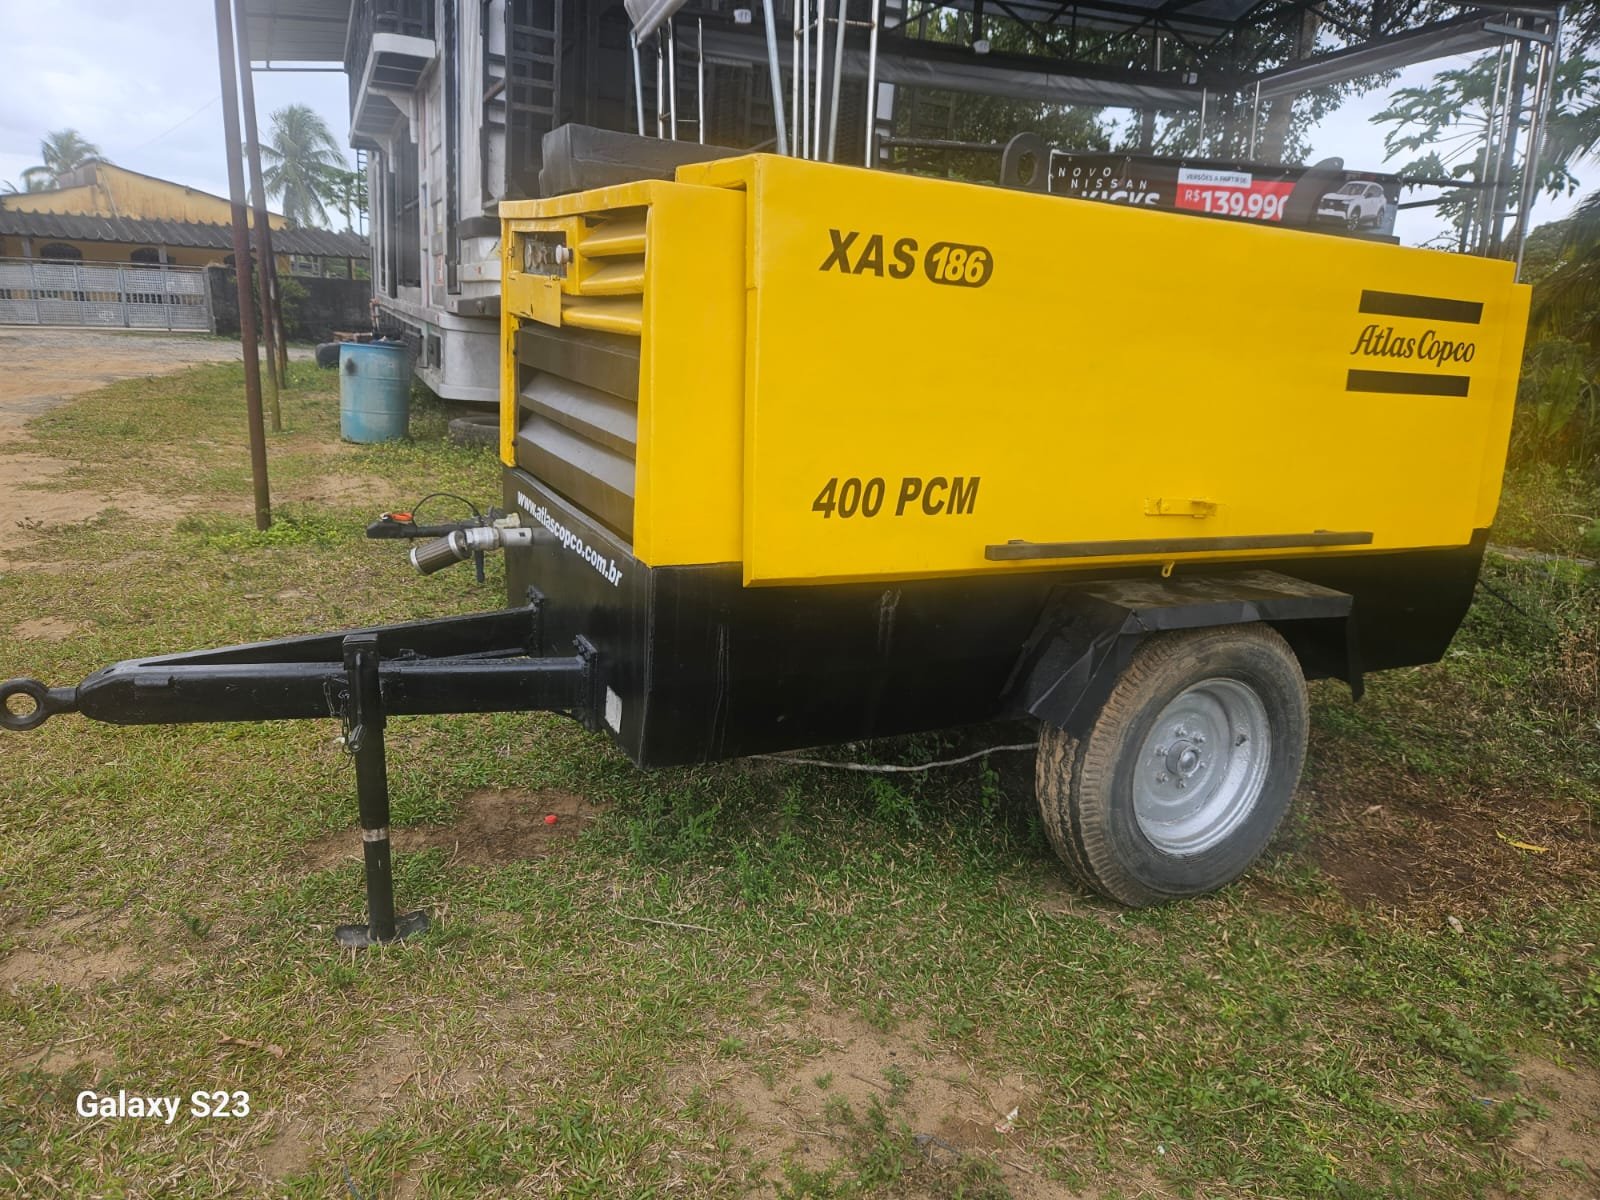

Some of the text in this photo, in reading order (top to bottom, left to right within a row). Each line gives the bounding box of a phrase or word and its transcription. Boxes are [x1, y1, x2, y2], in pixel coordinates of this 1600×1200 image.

[1058, 167, 1112, 177] NOVO
[1070, 179, 1148, 190] NISSAN
[819, 229, 987, 283] XAS 186
[1350, 324, 1475, 368] Atlas Copco
[812, 476, 981, 519] 400 PCM
[517, 490, 622, 587] www.atlascopco.com.br
